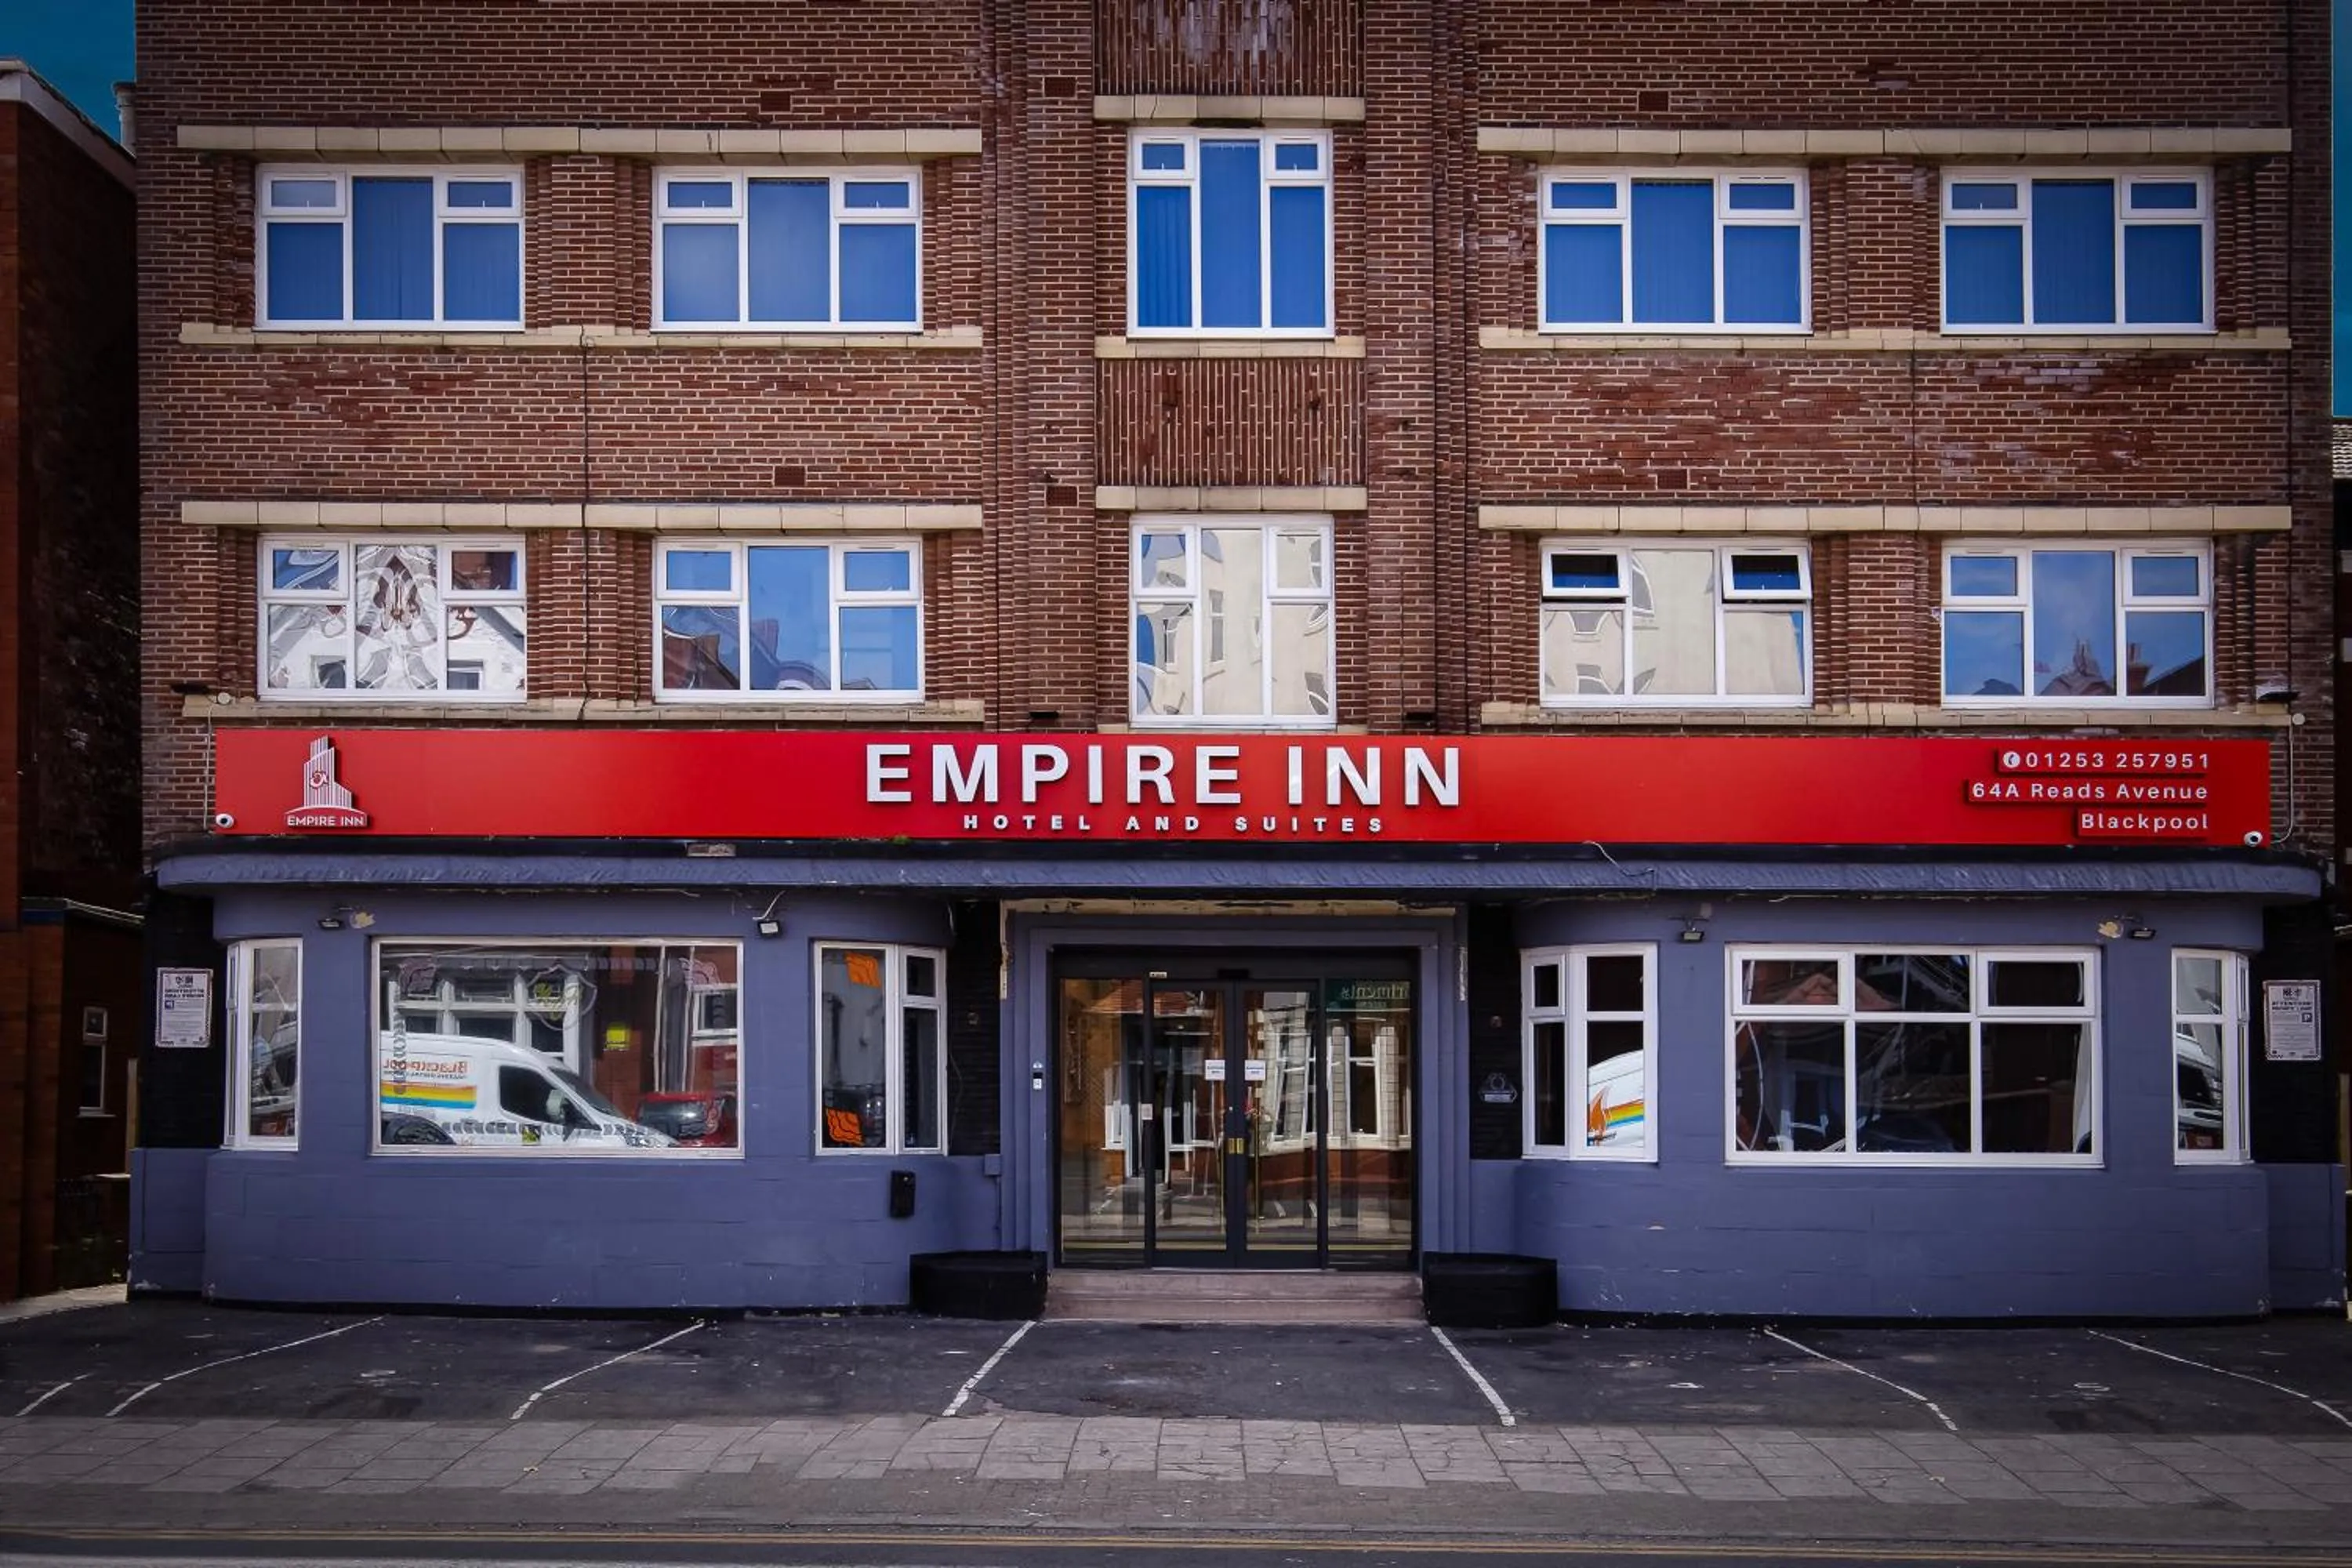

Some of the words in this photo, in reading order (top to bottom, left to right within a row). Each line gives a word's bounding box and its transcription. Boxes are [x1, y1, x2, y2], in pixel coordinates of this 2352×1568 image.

[2027, 753, 2103, 767] 01253
[2117, 754, 2208, 767] 257951
[867, 745, 1240, 803] EMPIRE
[1289, 746, 1458, 805] INN
[1973, 783, 2019, 797] 64A
[2032, 784, 2103, 797] Reads
[2117, 785, 2208, 798] Avenue
[288, 816, 335, 826] EMPIRE
[342, 817, 363, 826] INN
[964, 815, 1090, 829] HOTEL
[1126, 816, 1198, 829] AND
[1236, 817, 1380, 832] SUITES
[2082, 815, 2208, 833] Blackpool
